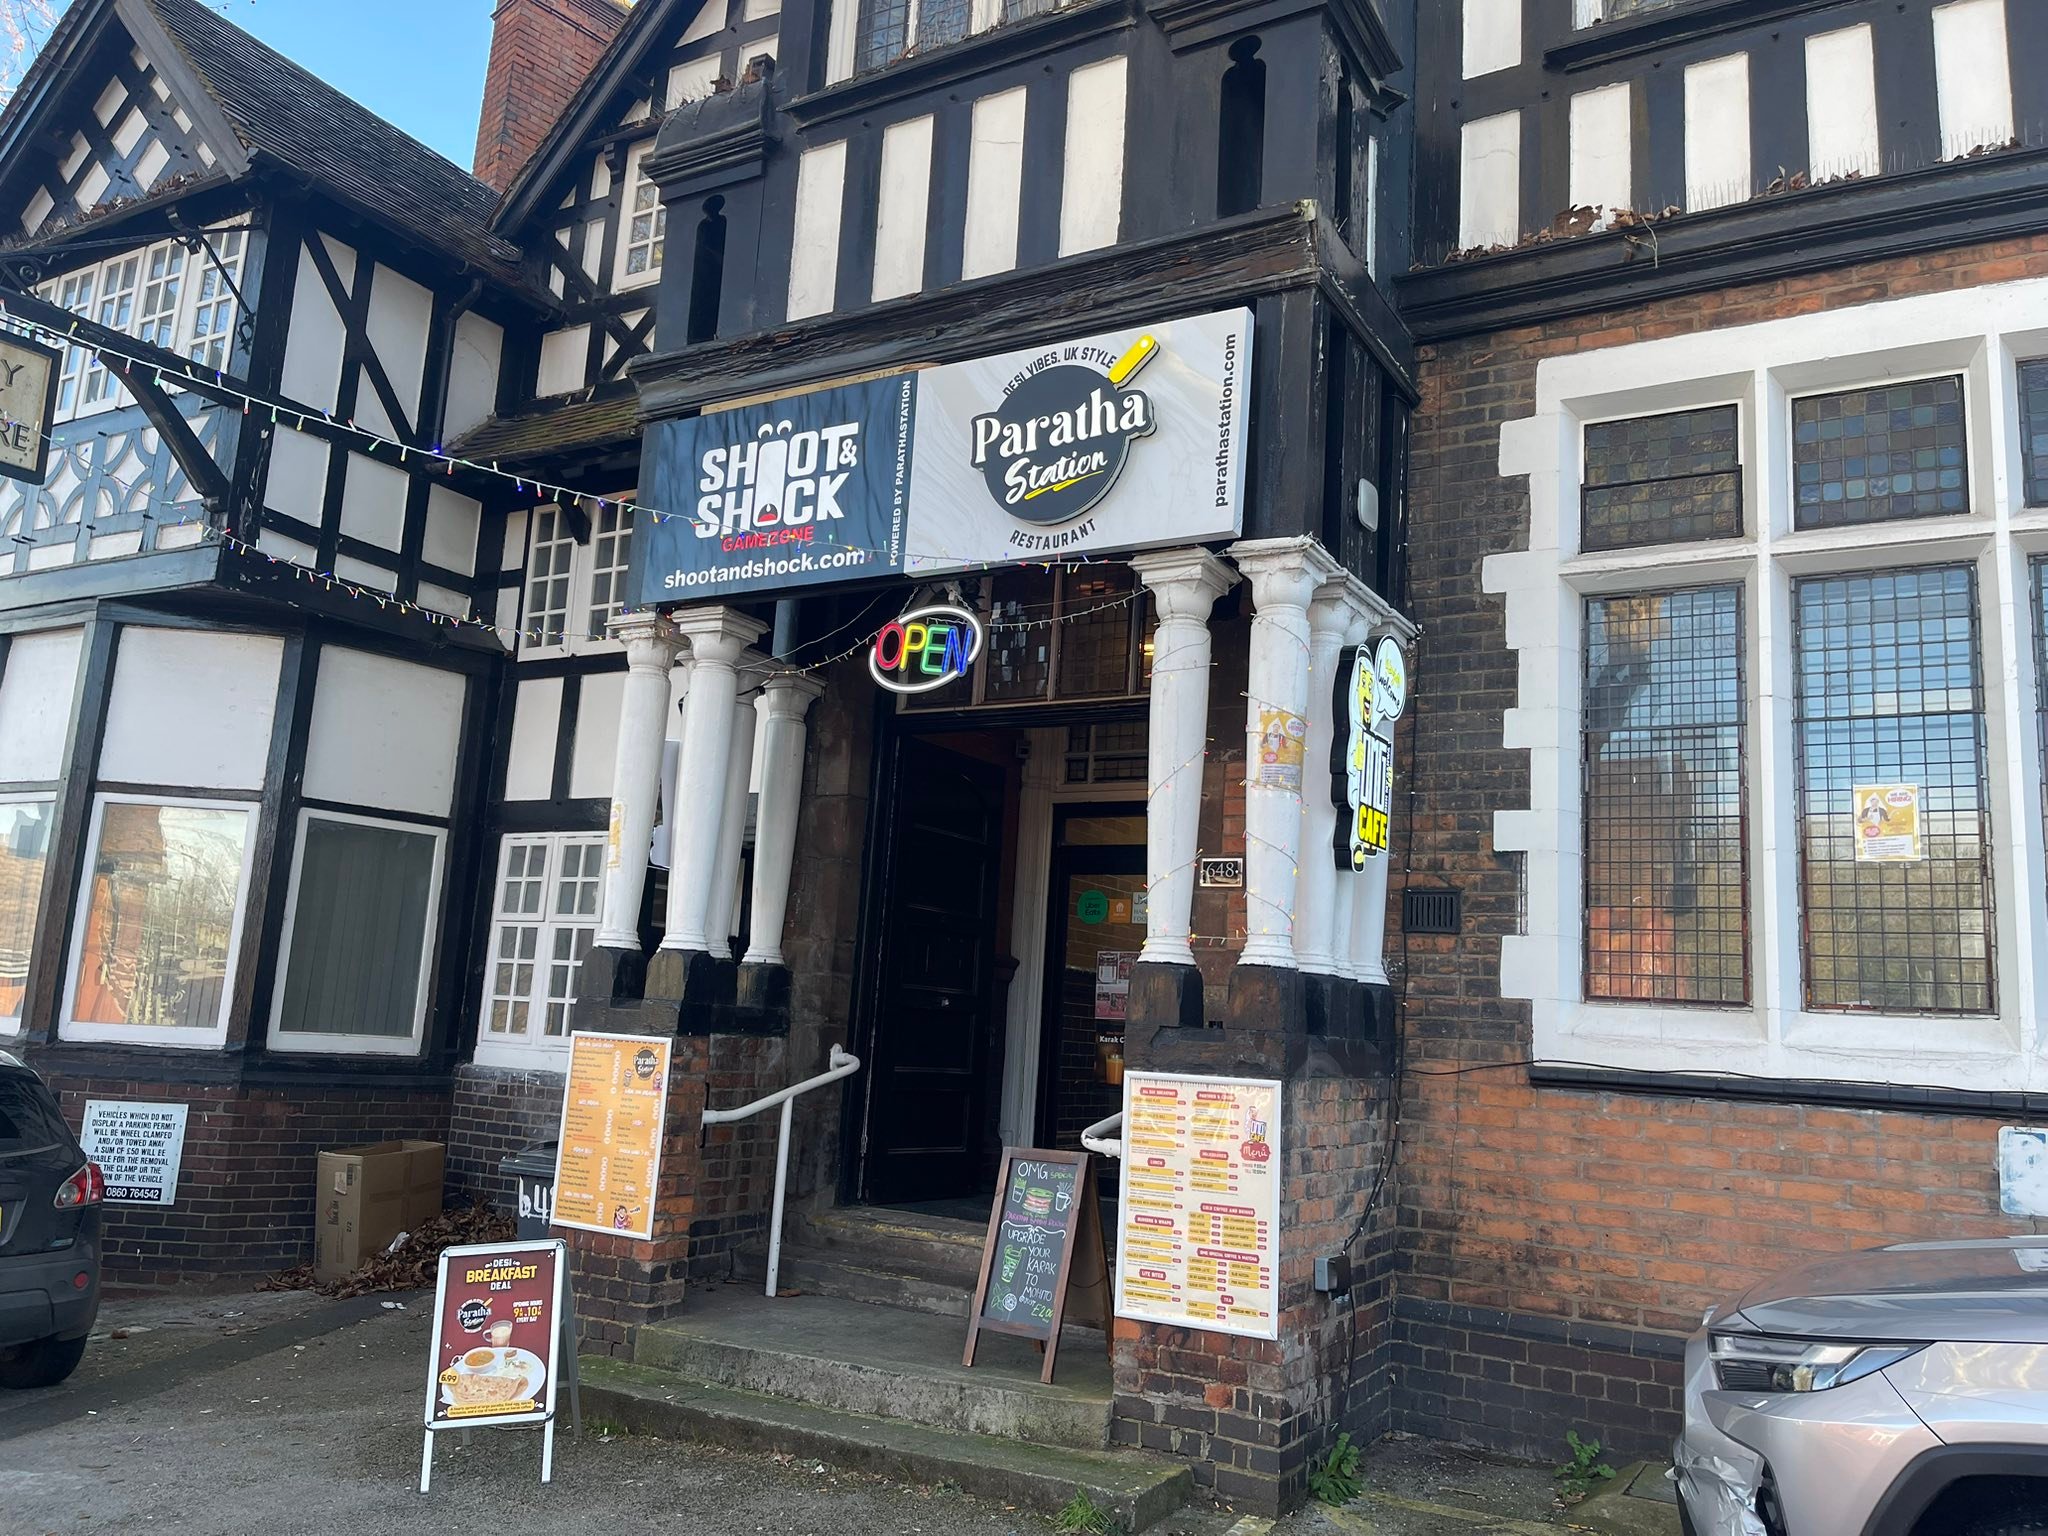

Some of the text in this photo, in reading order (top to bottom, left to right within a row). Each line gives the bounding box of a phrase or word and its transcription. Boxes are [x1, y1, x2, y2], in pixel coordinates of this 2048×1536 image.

[1002, 346, 1117, 398] DESI VIBES. UK STYLE
[975, 387, 1146, 464] Paratha
[1215, 333, 1237, 508] parathastation.com
[889, 380, 911, 567] POWERED BY PARATHASTATION
[1004, 450, 1108, 505] Station
[722, 526, 815, 553] GAMEZONE
[1009, 518, 1096, 550] RESTAURANT
[663, 548, 865, 590] shootandshock.com
[875, 621, 974, 678] OPEN
[1359, 804, 1388, 850] CAFE
[1206, 862, 1234, 878] 648
[98, 1110, 128, 1119] VEHICLES
[129, 1112, 149, 1120] WHICH
[92, 1119, 117, 1127] DISPLAY
[125, 1121, 151, 1129] PARKING
[153, 1122, 177, 1130] PERMIT
[93, 1128, 108, 1136] WILL
[120, 1129, 141, 1137] WHEEL
[143, 1131, 172, 1139] CLAMPED
[98, 1137, 123, 1145] AND/OR
[126, 1138, 146, 1146] TOWED
[126, 1148, 139, 1156] £50
[158, 1149, 166, 1157] BE
[103, 1164, 114, 1172] THE
[116, 1165, 138, 1173] CLAMP
[140, 1166, 149, 1174] OR
[113, 1156, 125, 1164] FOR
[128, 1156, 138, 1164] THE
[140, 1157, 169, 1166] REMOVAL
[114, 1173, 122, 1181] OF
[124, 1174, 136, 1182] THE
[138, 1175, 163, 1183] VEHICLE
[1018, 1161, 1049, 1180] OMG
[106, 1187, 159, 1199] 0860 764542
[1008, 1229, 1046, 1245] UPGRADE
[1028, 1245, 1051, 1258] YOUR
[493, 1258, 512, 1268] DESI
[1026, 1257, 1057, 1275] KARAK
[466, 1265, 538, 1283] BREAKFAST
[1025, 1272, 1039, 1286] TO
[490, 1281, 512, 1291] DEAL
[457, 1306, 492, 1320] Paratha
